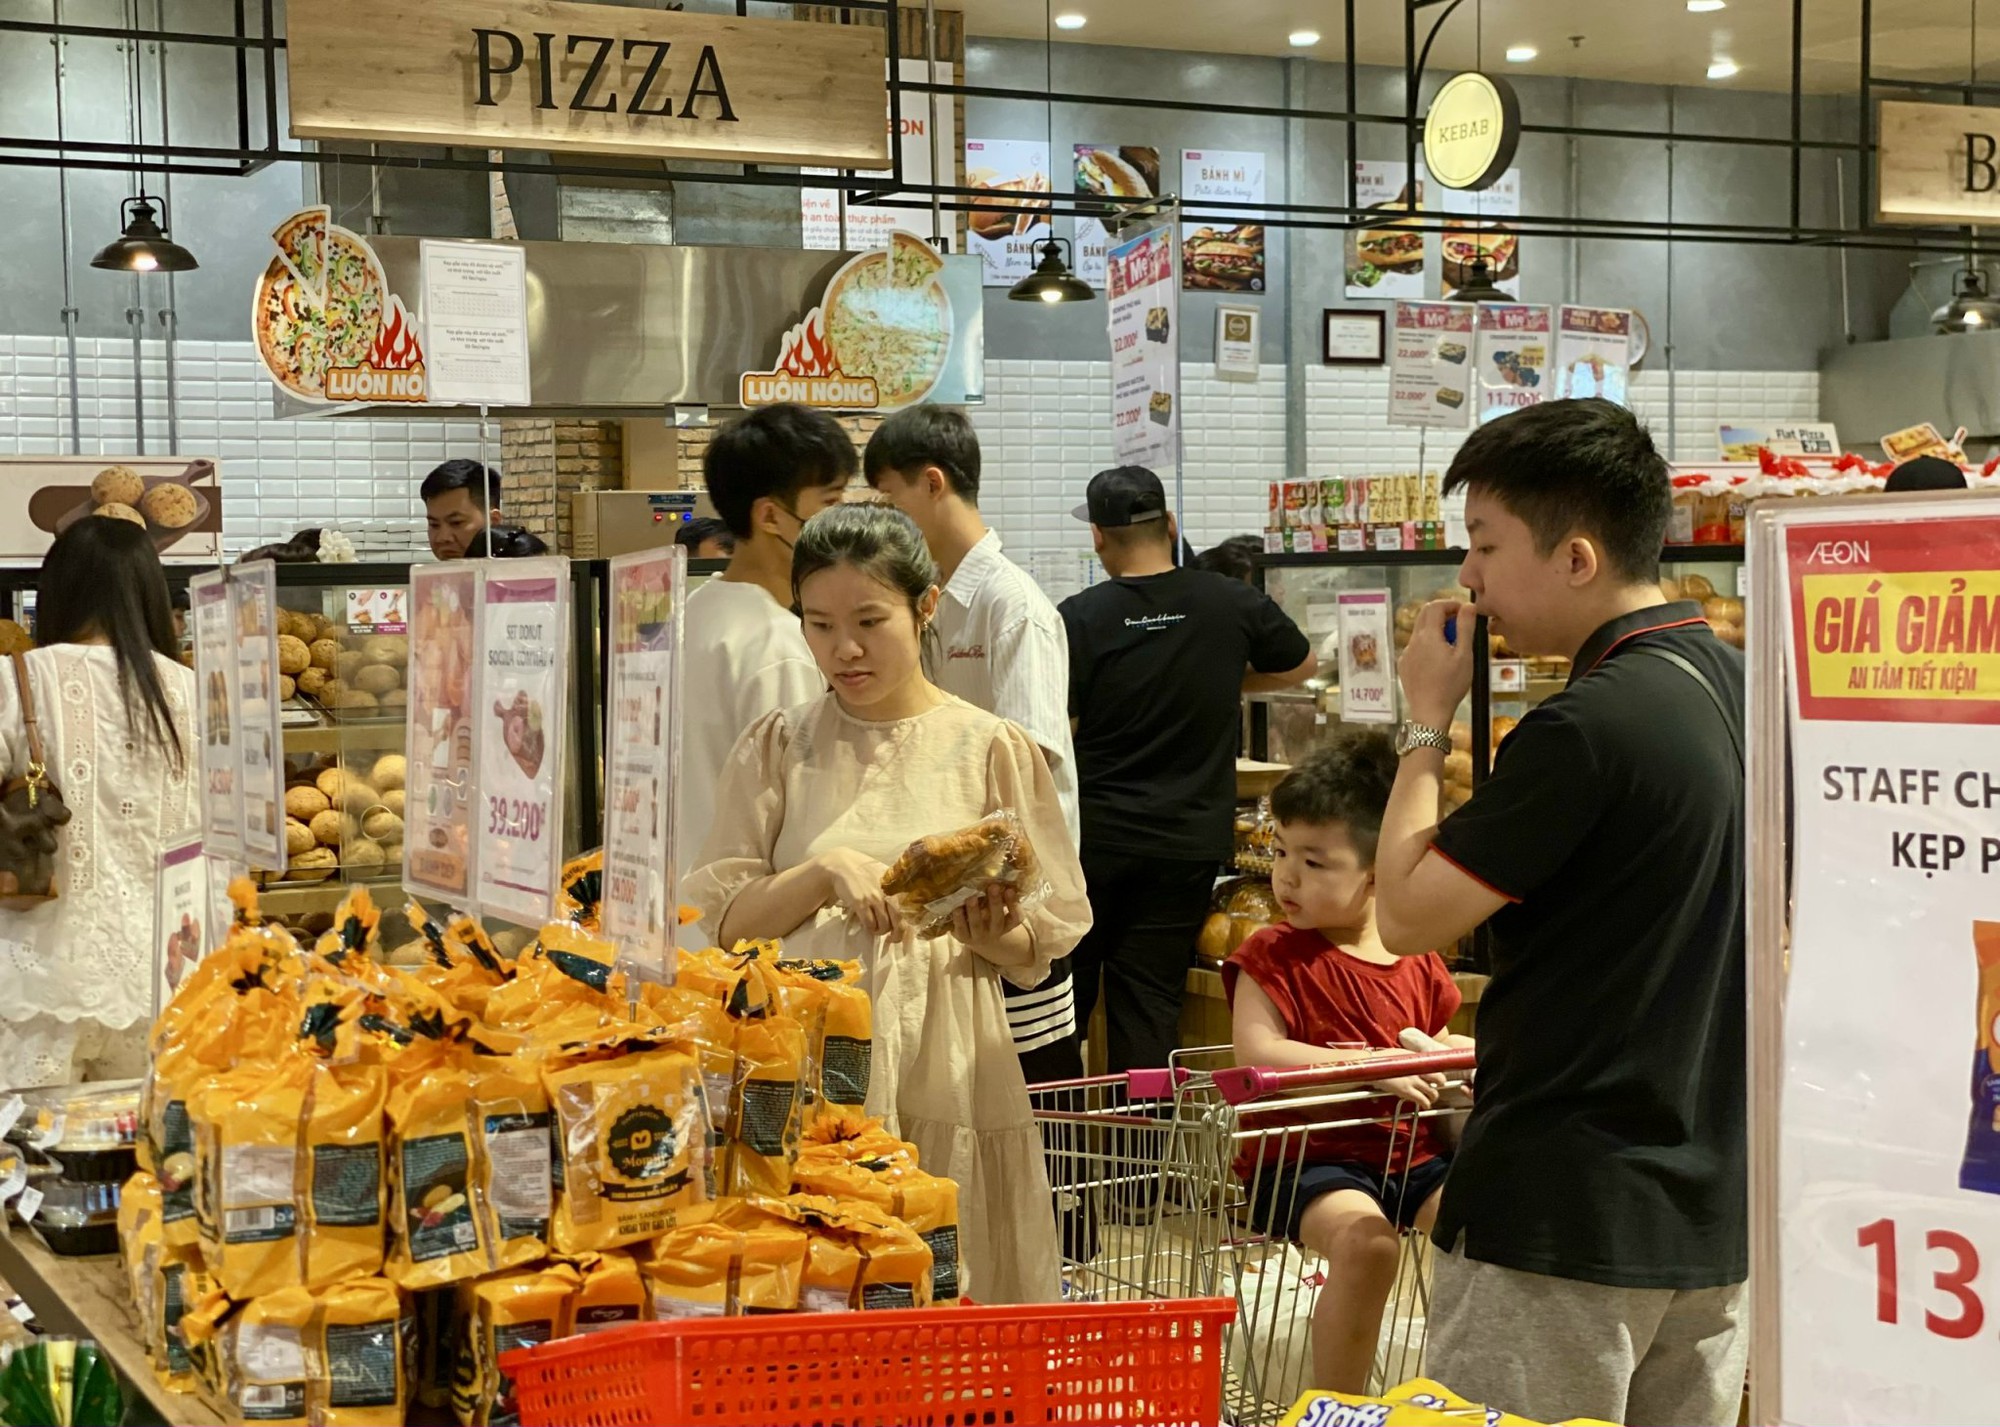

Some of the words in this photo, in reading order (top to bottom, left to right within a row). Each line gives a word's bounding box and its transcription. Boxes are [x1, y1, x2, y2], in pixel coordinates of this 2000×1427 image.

[472, 28, 739, 122] PIZZA
[1438, 119, 1489, 143] KEBAB
[1202, 166, 1230, 182] BÁNH
[1234, 167, 1246, 182] MÌ
[1130, 257, 1149, 285] Mẹ
[330, 367, 388, 396] LUÔN
[747, 375, 808, 402] LUÔN
[812, 375, 875, 403] NÓNG
[1776, 428, 1796, 439] Flat
[1799, 429, 1825, 440] Pizza
[1813, 579, 1882, 655] GIÁ
[1896, 577, 2000, 655] GIẢM
[1848, 666, 1868, 690] AN
[1872, 660, 1904, 691] TÂM
[1908, 660, 1937, 690] TIẾT
[1939, 661, 1978, 694] KIỆM
[1823, 765, 1940, 806] STAFF
[1892, 831, 1966, 879] KẸP
